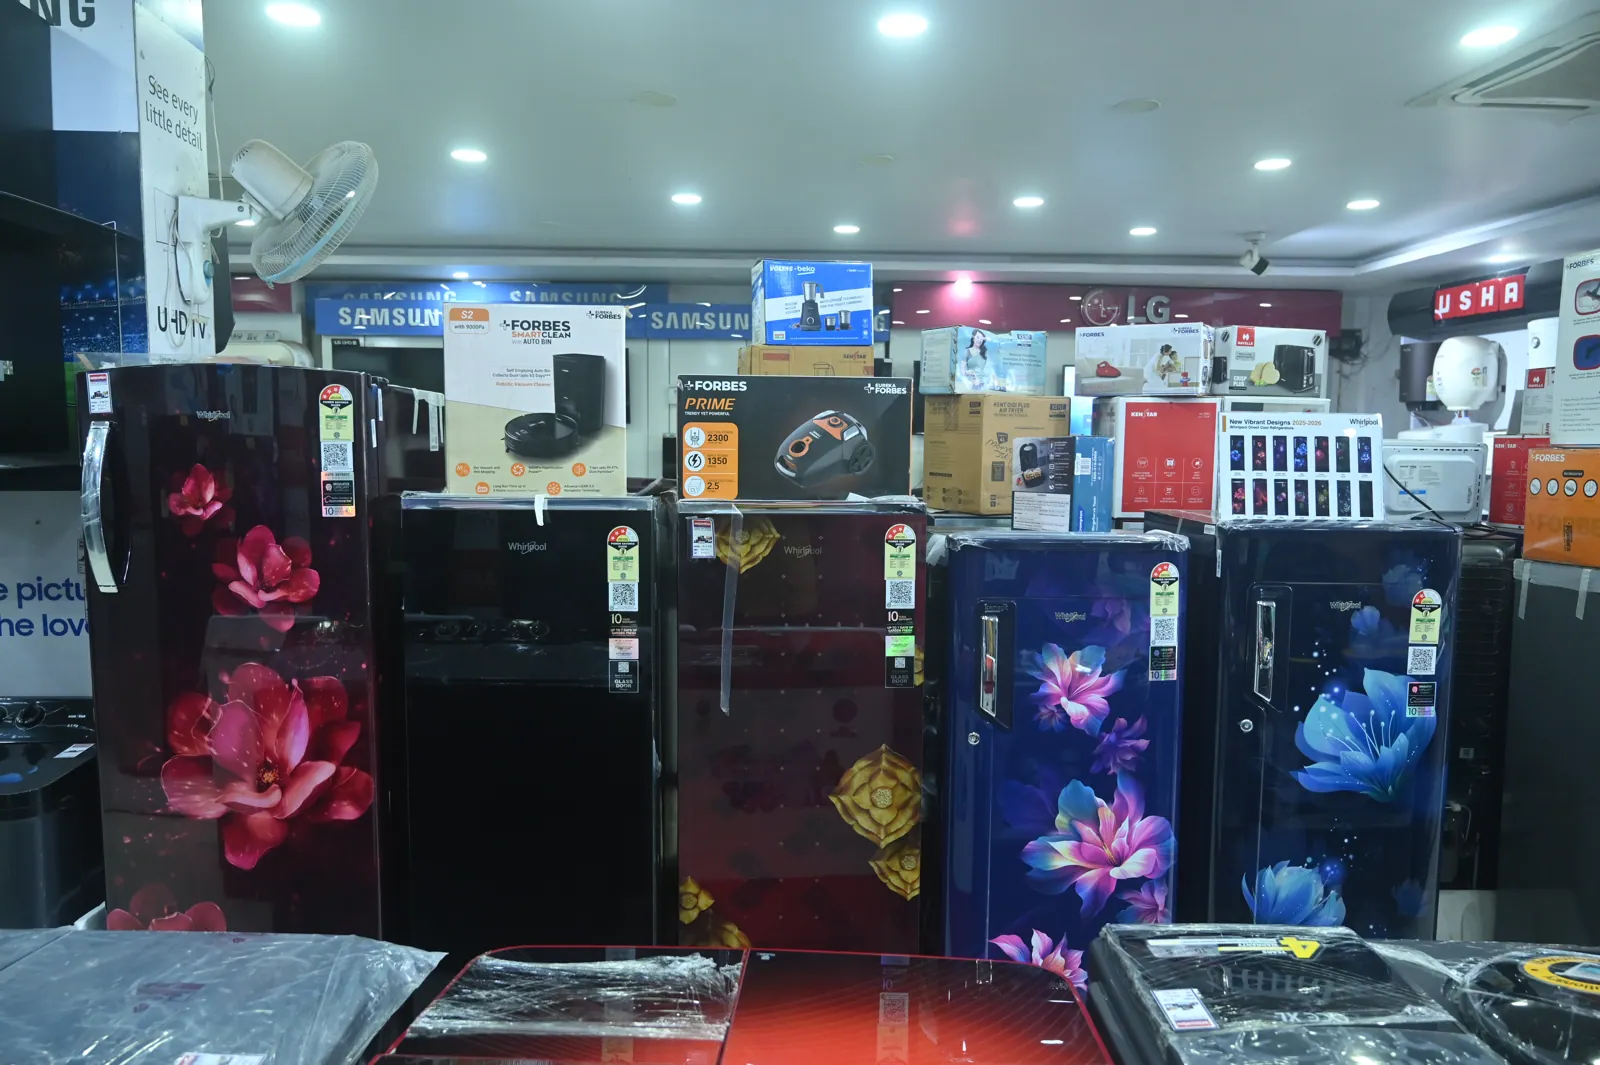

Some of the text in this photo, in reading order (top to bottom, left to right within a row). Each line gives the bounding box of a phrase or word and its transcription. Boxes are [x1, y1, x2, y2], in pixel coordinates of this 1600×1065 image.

[148, 74, 198, 125] See every
[146, 100, 202, 152] little detail
[1570, 258, 1594, 270] FORBES
[1438, 282, 1518, 314] USHA
[338, 306, 444, 326] SAMSUN
[460, 310, 474, 319] S2
[1126, 296, 1170, 324] LG
[512, 320, 570, 331] FORBES
[651, 312, 750, 330] SAMSUN
[694, 380, 748, 391] FORBES
[684, 398, 736, 410] PRIME
[196, 410, 230, 421] Whirlpool
[1131, 409, 1158, 418] KENSTAR
[1350, 418, 1378, 427] Whirlpool
[1534, 454, 1565, 462] FORBES
[324, 507, 334, 515] 10
[508, 541, 546, 554] Whirlpool
[784, 545, 822, 558] Whirlpool
[612, 613, 622, 624] 10
[888, 611, 899, 621] 10
[42, 614, 90, 636] lov
[1280, 937, 1320, 958] 4
[1274, 1012, 1301, 1022] XL
